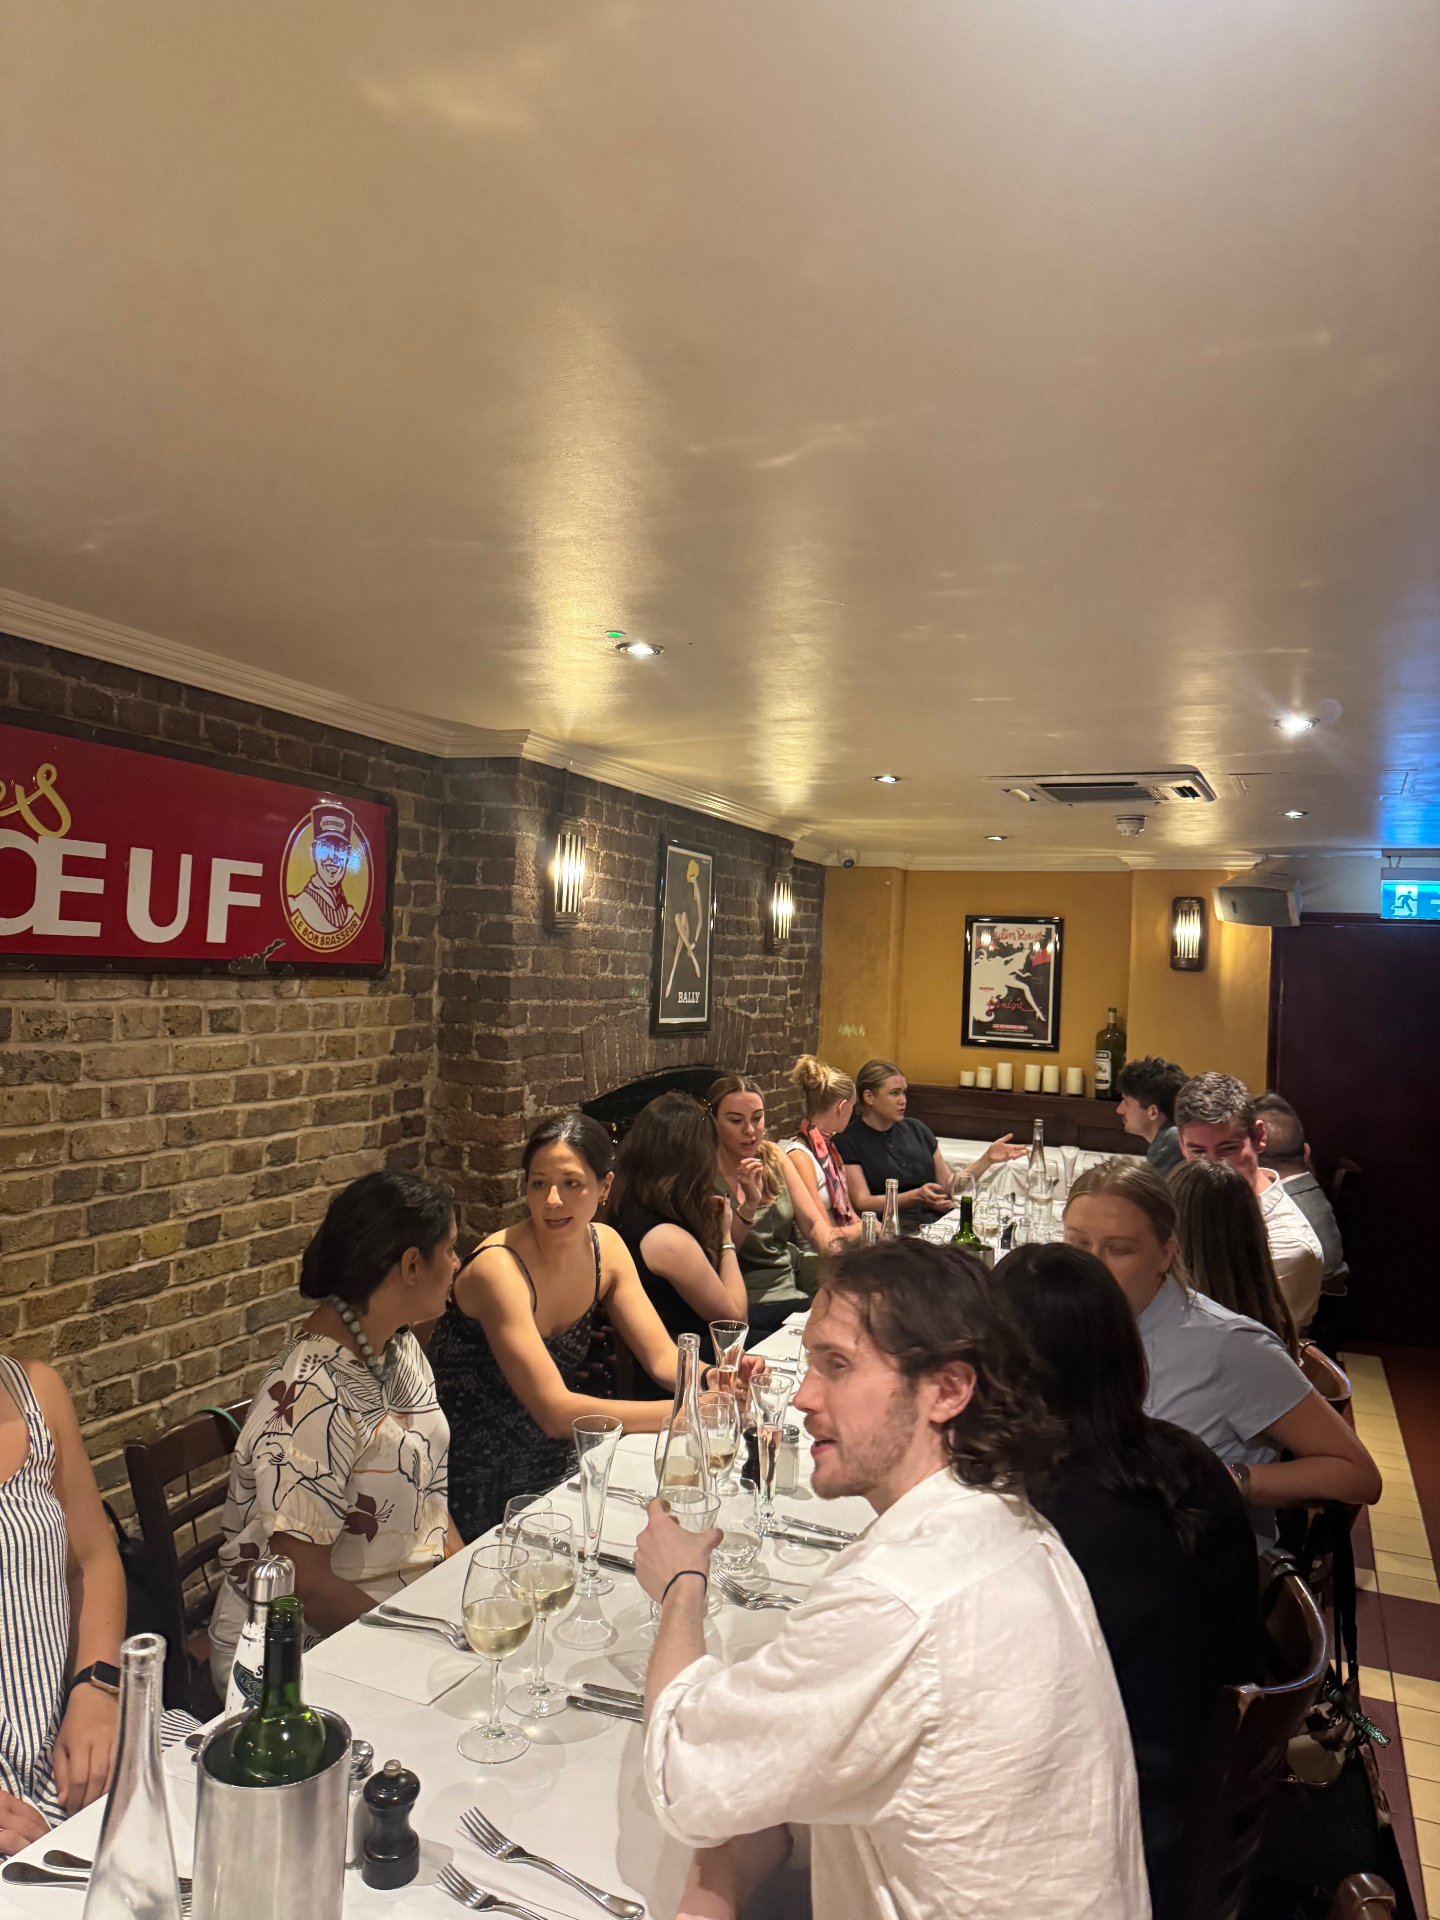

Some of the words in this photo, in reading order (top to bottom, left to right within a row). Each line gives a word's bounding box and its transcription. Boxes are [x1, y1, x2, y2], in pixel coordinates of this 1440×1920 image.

[293, 915, 303, 930] LE
[302, 927, 319, 944] BON
[320, 920, 359, 946] BRASSEUR
[677, 991, 701, 1004] BALLY
